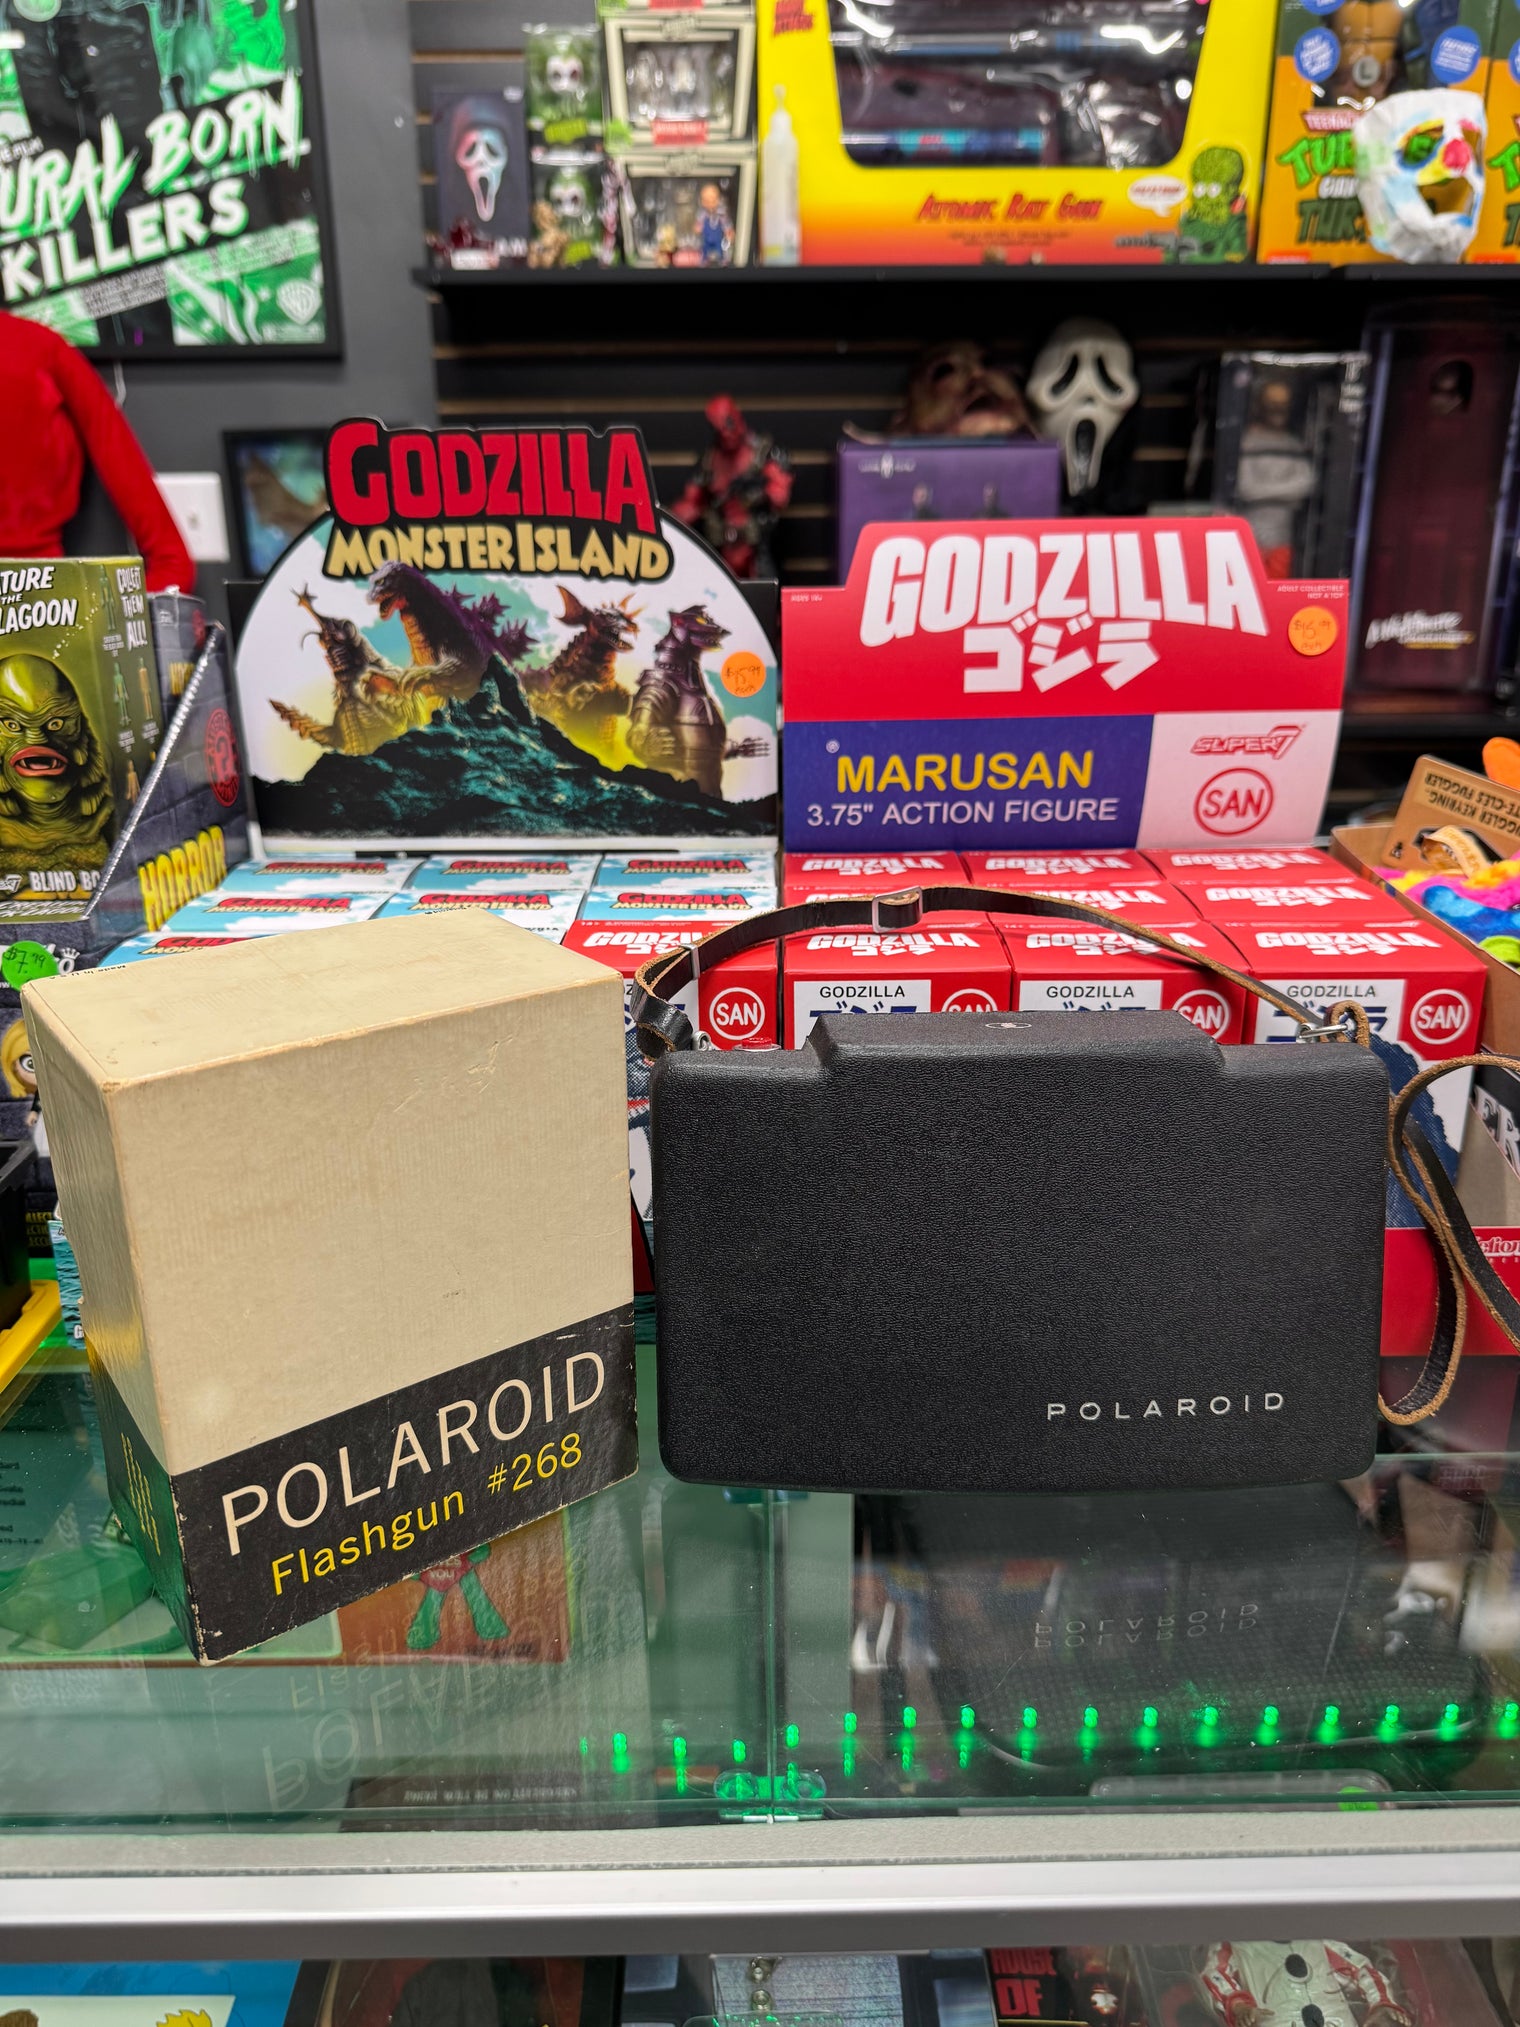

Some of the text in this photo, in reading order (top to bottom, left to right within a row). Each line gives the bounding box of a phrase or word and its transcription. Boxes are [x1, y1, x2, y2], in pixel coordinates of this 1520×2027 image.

[142, 68, 302, 196] BORN
[1, 178, 249, 303] KILLERS
[328, 422, 656, 534] GODZILLA
[326, 522, 671, 580] MONSTER ISLAND
[860, 531, 1268, 647] GODZILLA
[963, 609, 1159, 693] ゴジラ
[837, 750, 1094, 793] MARUSAN
[807, 798, 1120, 827] 3.75" ACTION FIGURE
[1202, 788, 1265, 818] SAN
[28, 870, 76, 892] BLIND
[79, 870, 101, 891] BO
[1205, 887, 1374, 901] GODZILLA
[807, 932, 981, 950] GODZILLA
[1255, 932, 1442, 949] GODZILLA
[819, 985, 906, 998] GODZILLA
[1046, 985, 1135, 998] GODZILLA
[1286, 985, 1377, 998] GODZILLA
[716, 1002, 759, 1026] SAN
[1417, 1006, 1464, 1030] SAN
[1047, 1392, 1284, 1420] POLAROID
[222, 1351, 606, 1556] POLAROID
[271, 1432, 583, 1596] Flashgun #268
[995, 1977, 1043, 2017] OF
